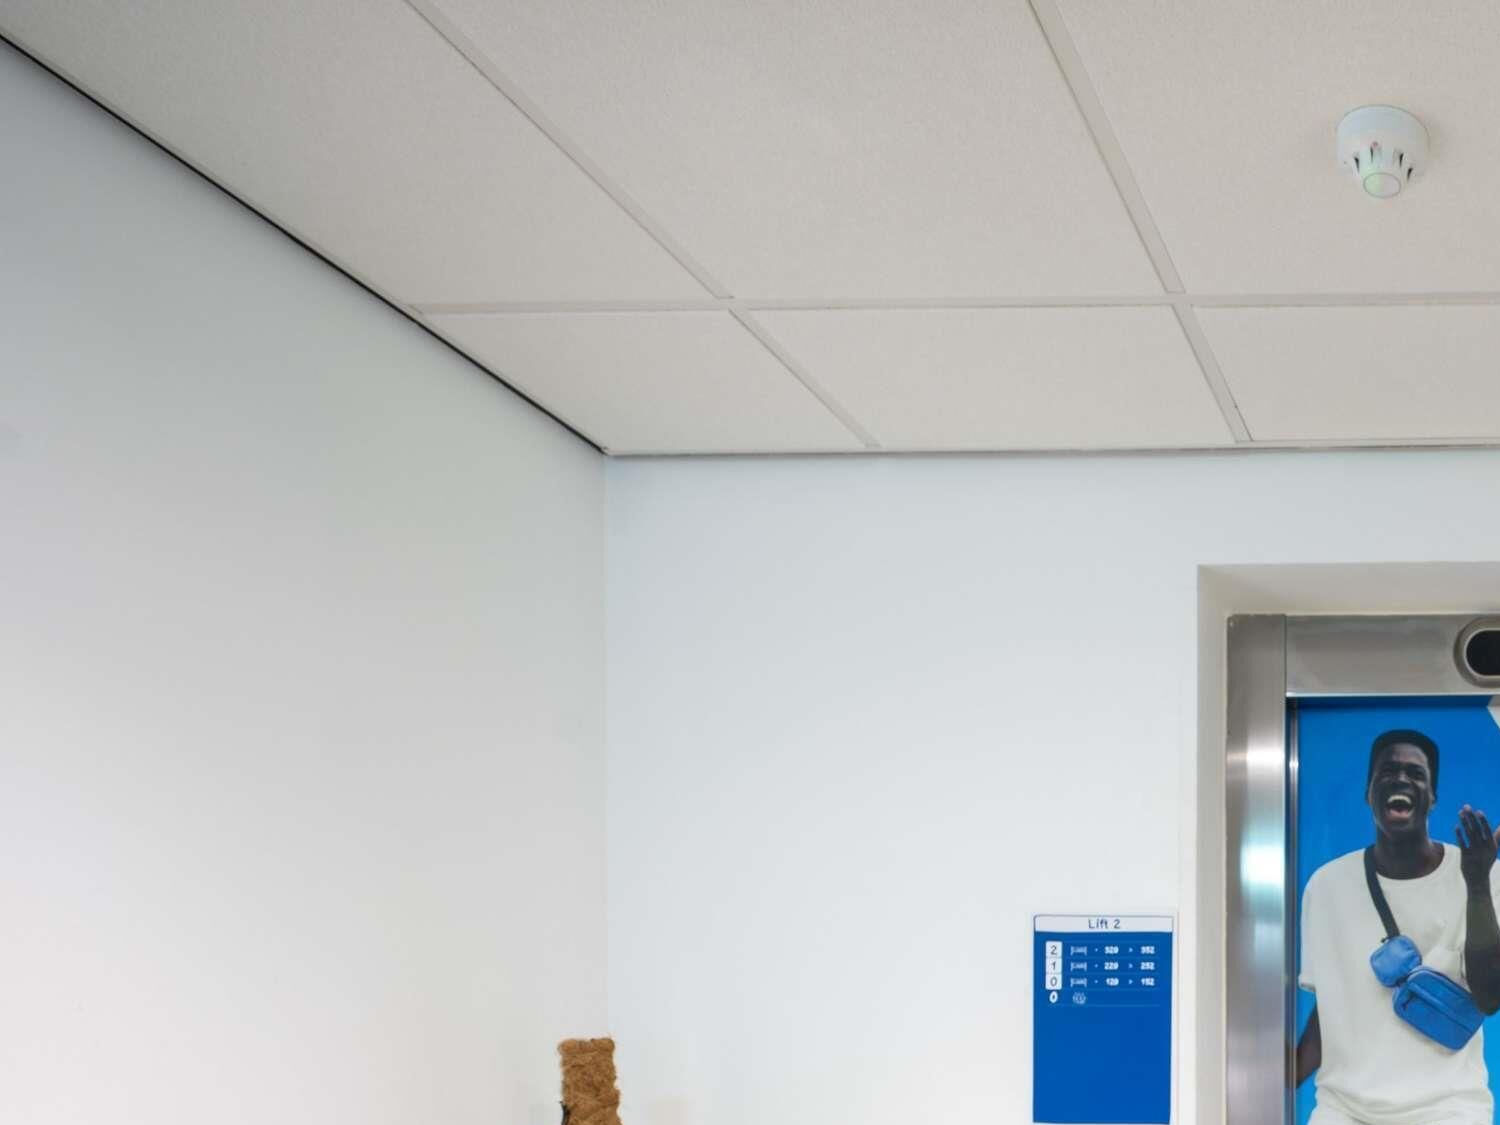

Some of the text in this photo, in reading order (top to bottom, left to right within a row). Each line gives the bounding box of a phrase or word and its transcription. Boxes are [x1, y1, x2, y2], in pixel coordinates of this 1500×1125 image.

[1088, 918, 1121, 929] Lift 2
[1050, 945, 1057, 955] 2
[1050, 976, 1057, 987] 0
[1049, 991, 1058, 1003] 0
